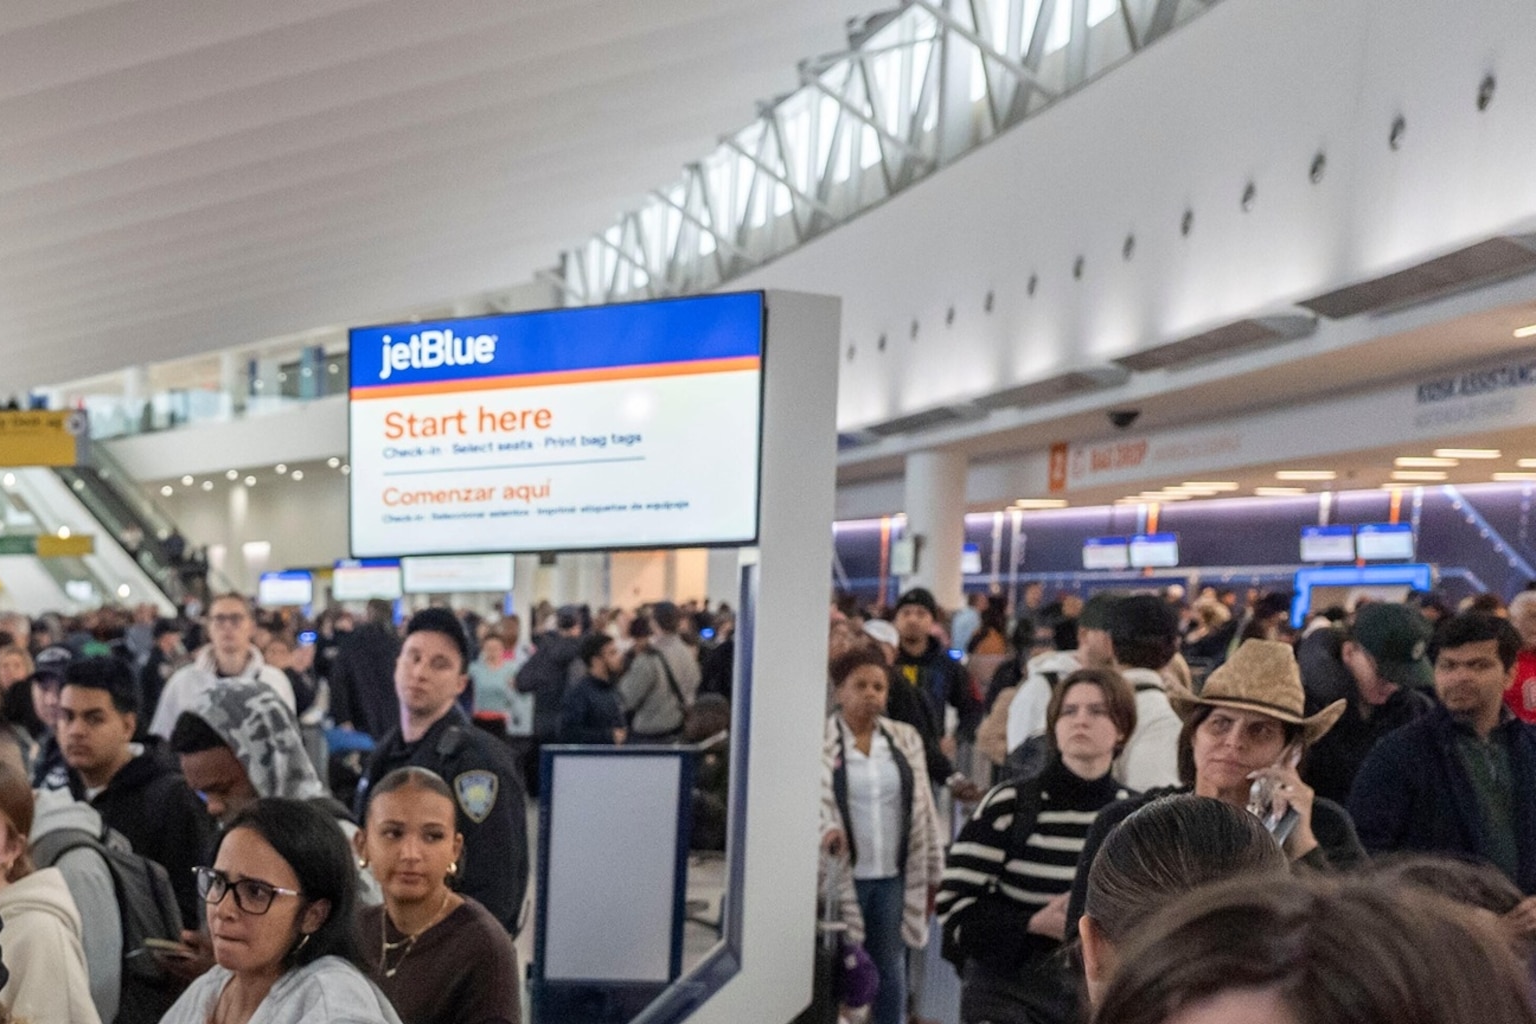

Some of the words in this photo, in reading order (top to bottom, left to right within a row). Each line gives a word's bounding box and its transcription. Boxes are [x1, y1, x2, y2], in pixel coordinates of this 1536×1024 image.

[379, 328, 496, 380] jetBlue
[384, 410, 468, 439] Start
[478, 405, 552, 432] here
[383, 445, 442, 460] Check-in
[452, 441, 494, 455] Select
[498, 438, 534, 451] seats
[544, 434, 577, 449] Print
[581, 433, 607, 449] bag
[611, 432, 642, 447] tags
[382, 485, 497, 507] Comenzar
